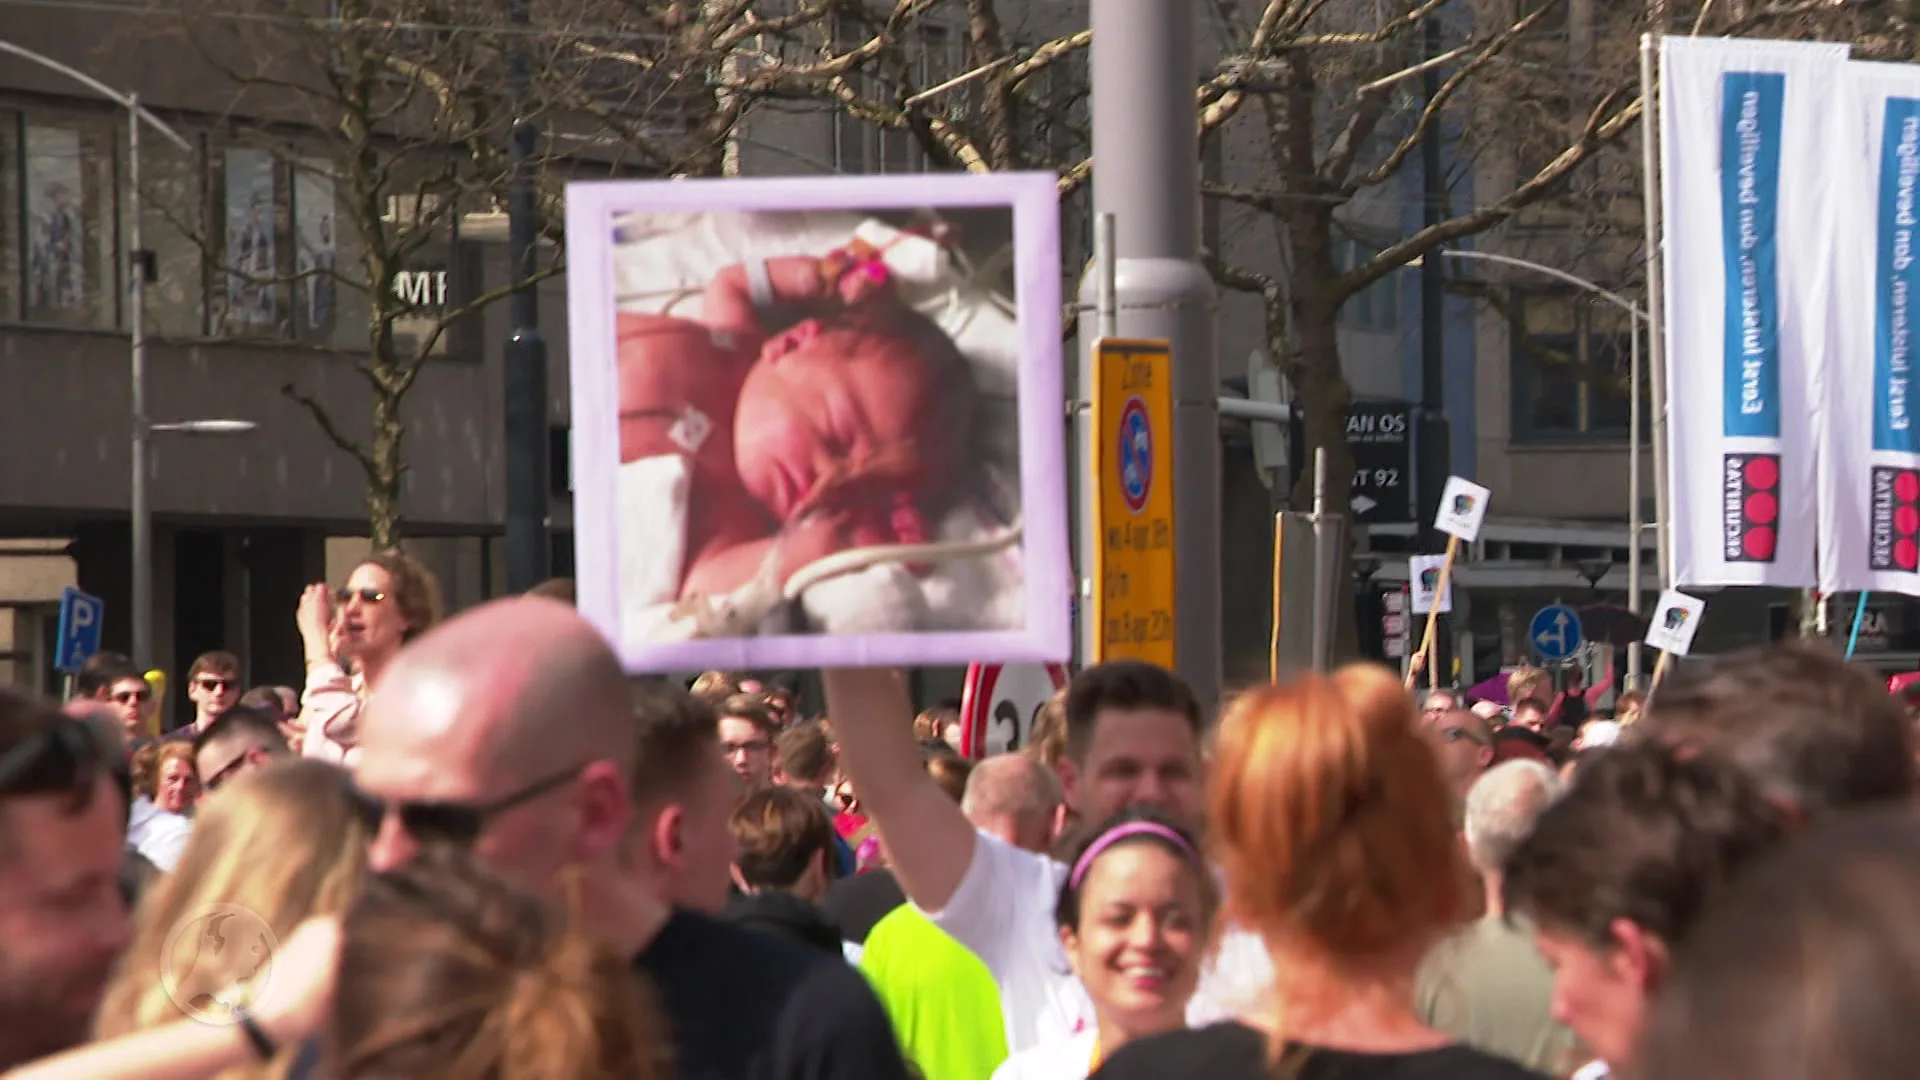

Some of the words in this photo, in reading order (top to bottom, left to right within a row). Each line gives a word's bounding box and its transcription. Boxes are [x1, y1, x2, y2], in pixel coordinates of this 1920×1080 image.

[1344, 415, 1375, 432] AN
[1380, 414, 1405, 432] OS
[1375, 469, 1399, 487] 92
[71, 598, 94, 638] P
